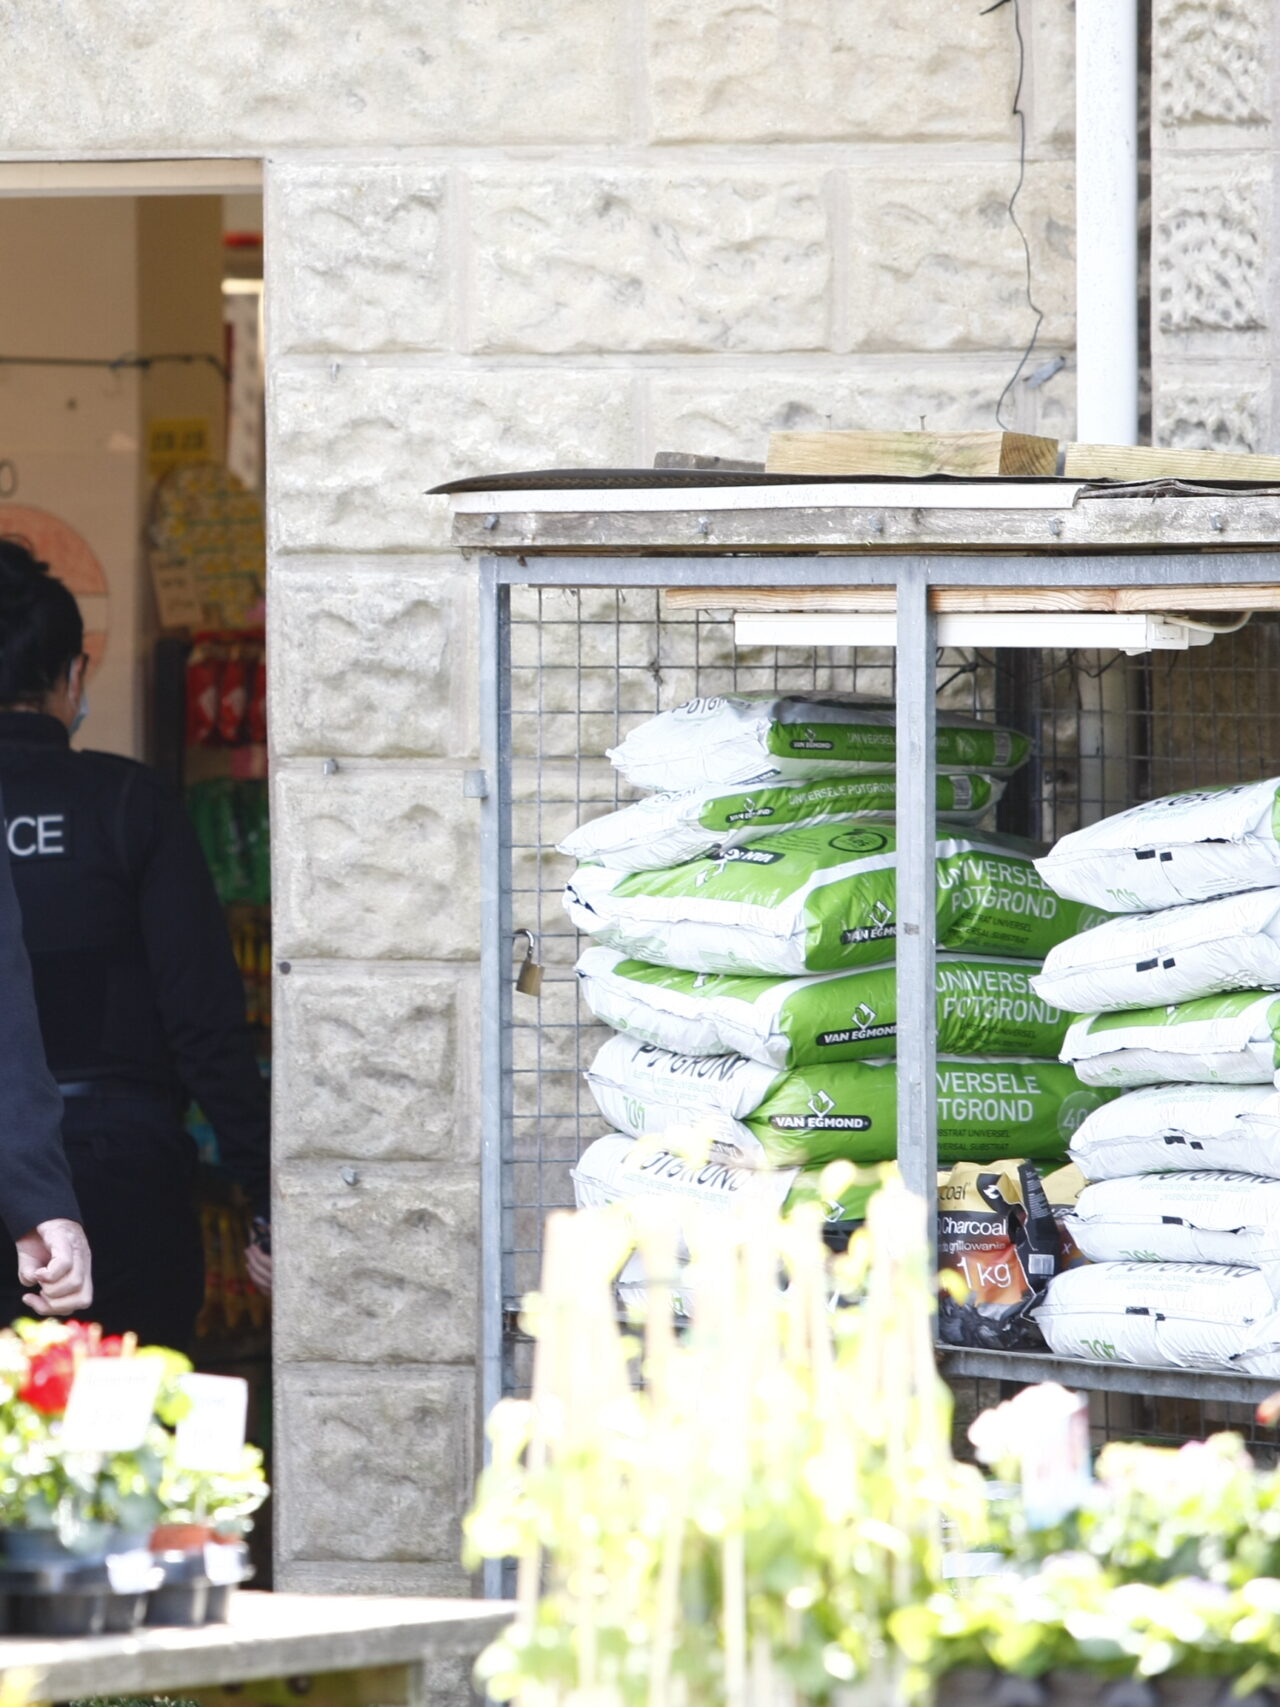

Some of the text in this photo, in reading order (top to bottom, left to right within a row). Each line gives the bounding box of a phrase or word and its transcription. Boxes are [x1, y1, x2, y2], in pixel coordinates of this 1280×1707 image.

[5, 815, 64, 856] CE
[951, 884, 1057, 919] POTGROND
[846, 929, 869, 942] VAN
[824, 1032, 849, 1043] VAN
[937, 1071, 1041, 1095] VERSELE
[937, 1098, 1034, 1122] TGROND
[775, 1116, 864, 1129] VAN EGMOND
[942, 1217, 1007, 1236] Charcoal
